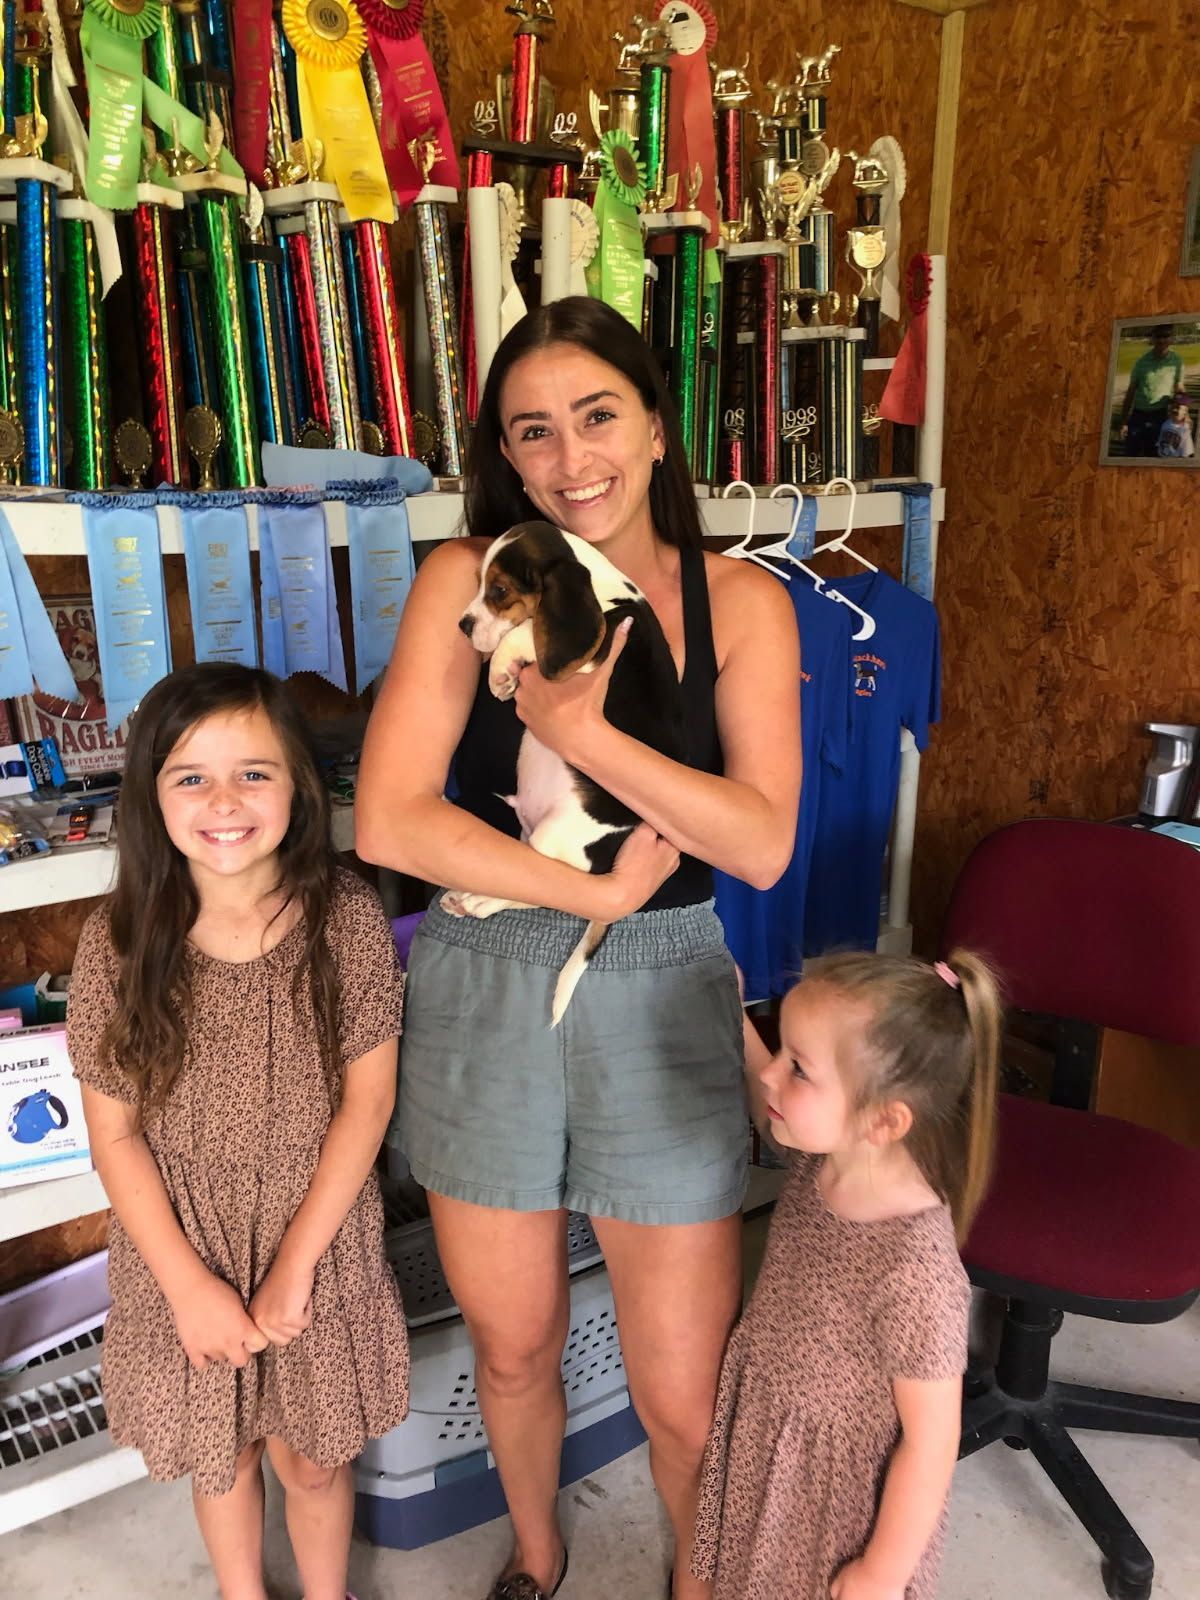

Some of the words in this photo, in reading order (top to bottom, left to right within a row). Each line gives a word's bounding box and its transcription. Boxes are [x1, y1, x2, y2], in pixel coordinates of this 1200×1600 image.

[474, 100, 496, 120] 08
[554, 112, 577, 132] 09
[724, 408, 745, 427] 08
[782, 406, 817, 429] 1998
